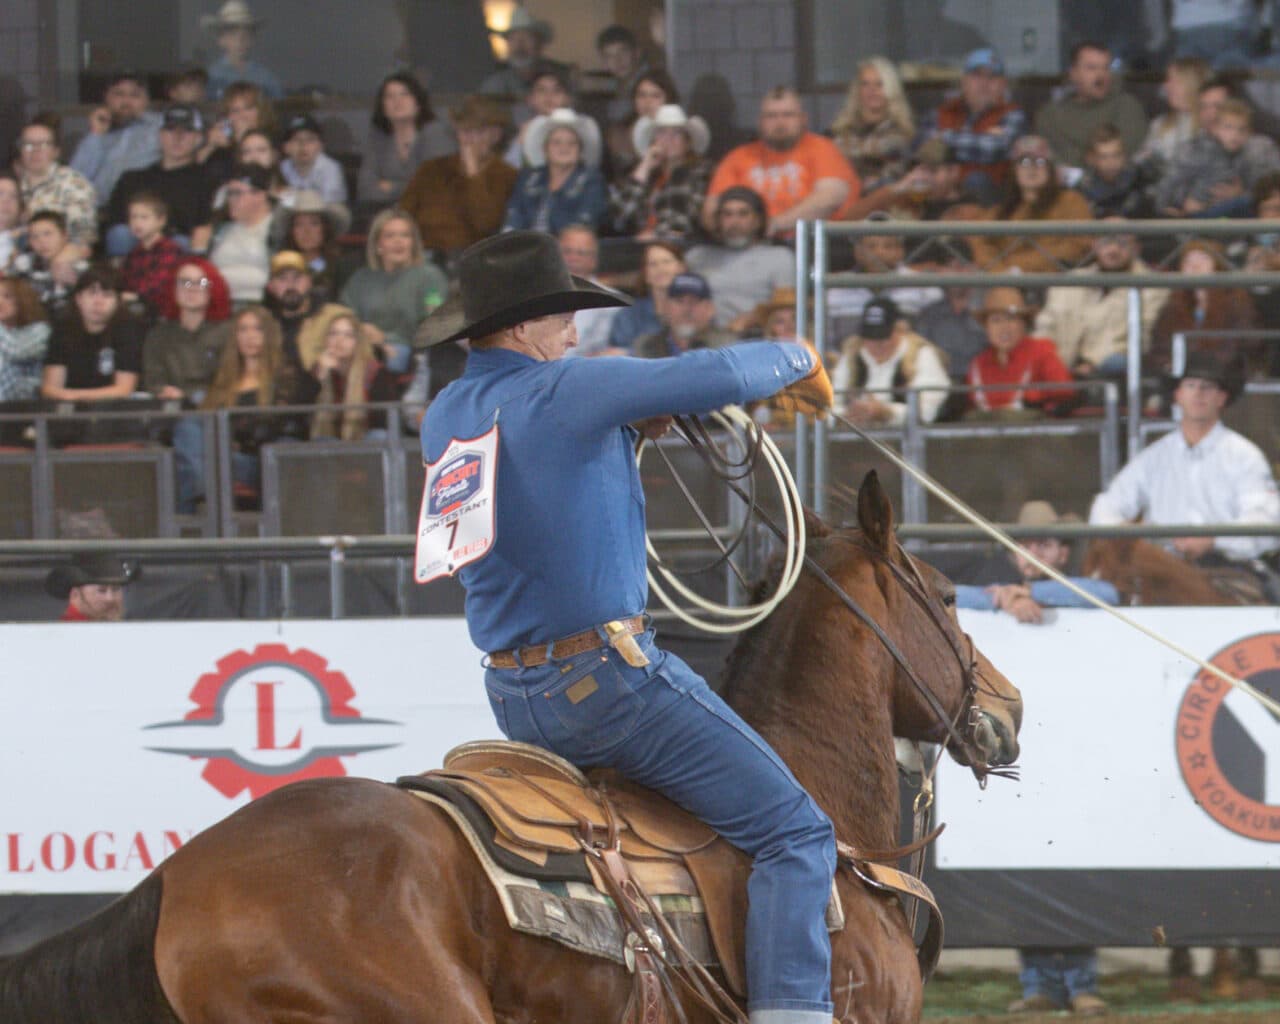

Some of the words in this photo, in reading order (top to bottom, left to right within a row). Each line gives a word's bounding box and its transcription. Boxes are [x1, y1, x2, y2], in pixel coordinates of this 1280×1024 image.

[421, 498, 488, 537] CONTESTANT
[446, 518, 459, 551] 7
[250, 681, 303, 751] L
[1181, 649, 1250, 741] CIRCE
